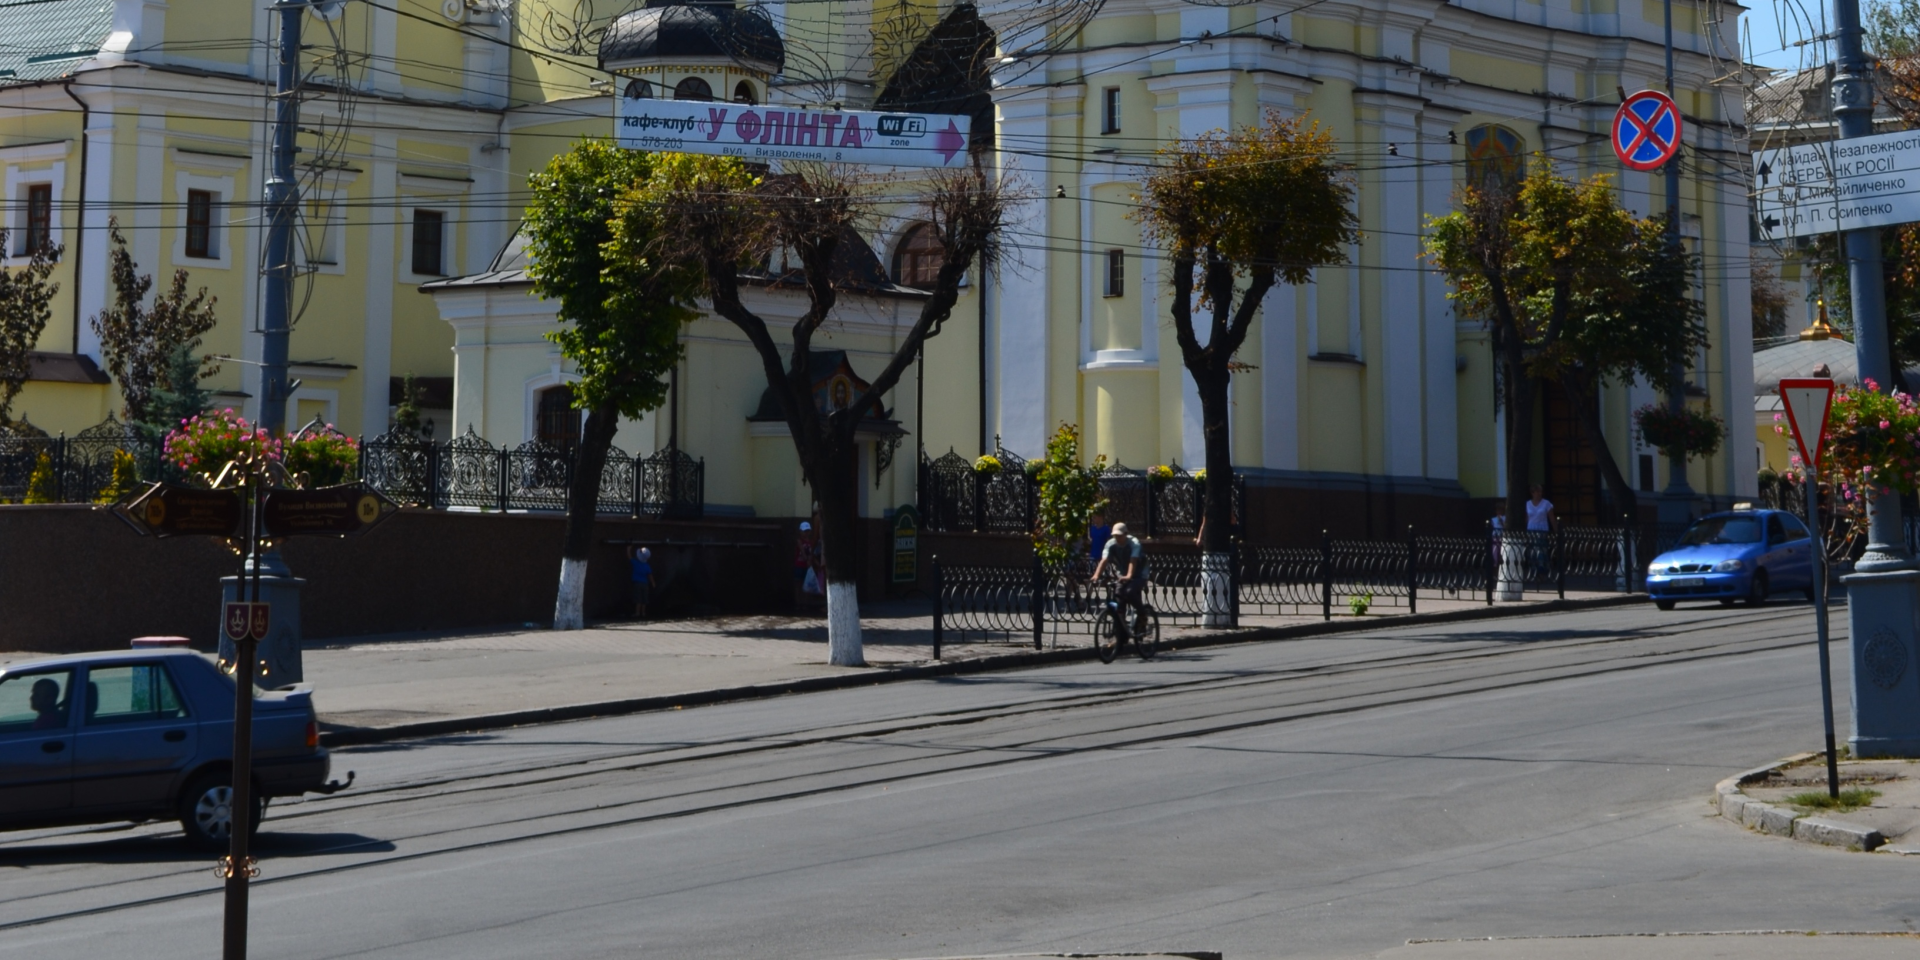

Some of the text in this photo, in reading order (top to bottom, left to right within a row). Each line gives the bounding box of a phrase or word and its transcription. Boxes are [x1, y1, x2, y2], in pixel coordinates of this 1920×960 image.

[623, 113, 695, 134] кафе-клуб
[882, 119, 921, 133] Wi Fi
[641, 136, 683, 149] 578-203
[890, 139, 910, 147] zone
[722, 147, 842, 161] вул. Визволення, 8
[1778, 154, 1895, 184] СБЕРБНК РОСІЇ
[1782, 203, 1893, 228] вул. П. Осипенко
